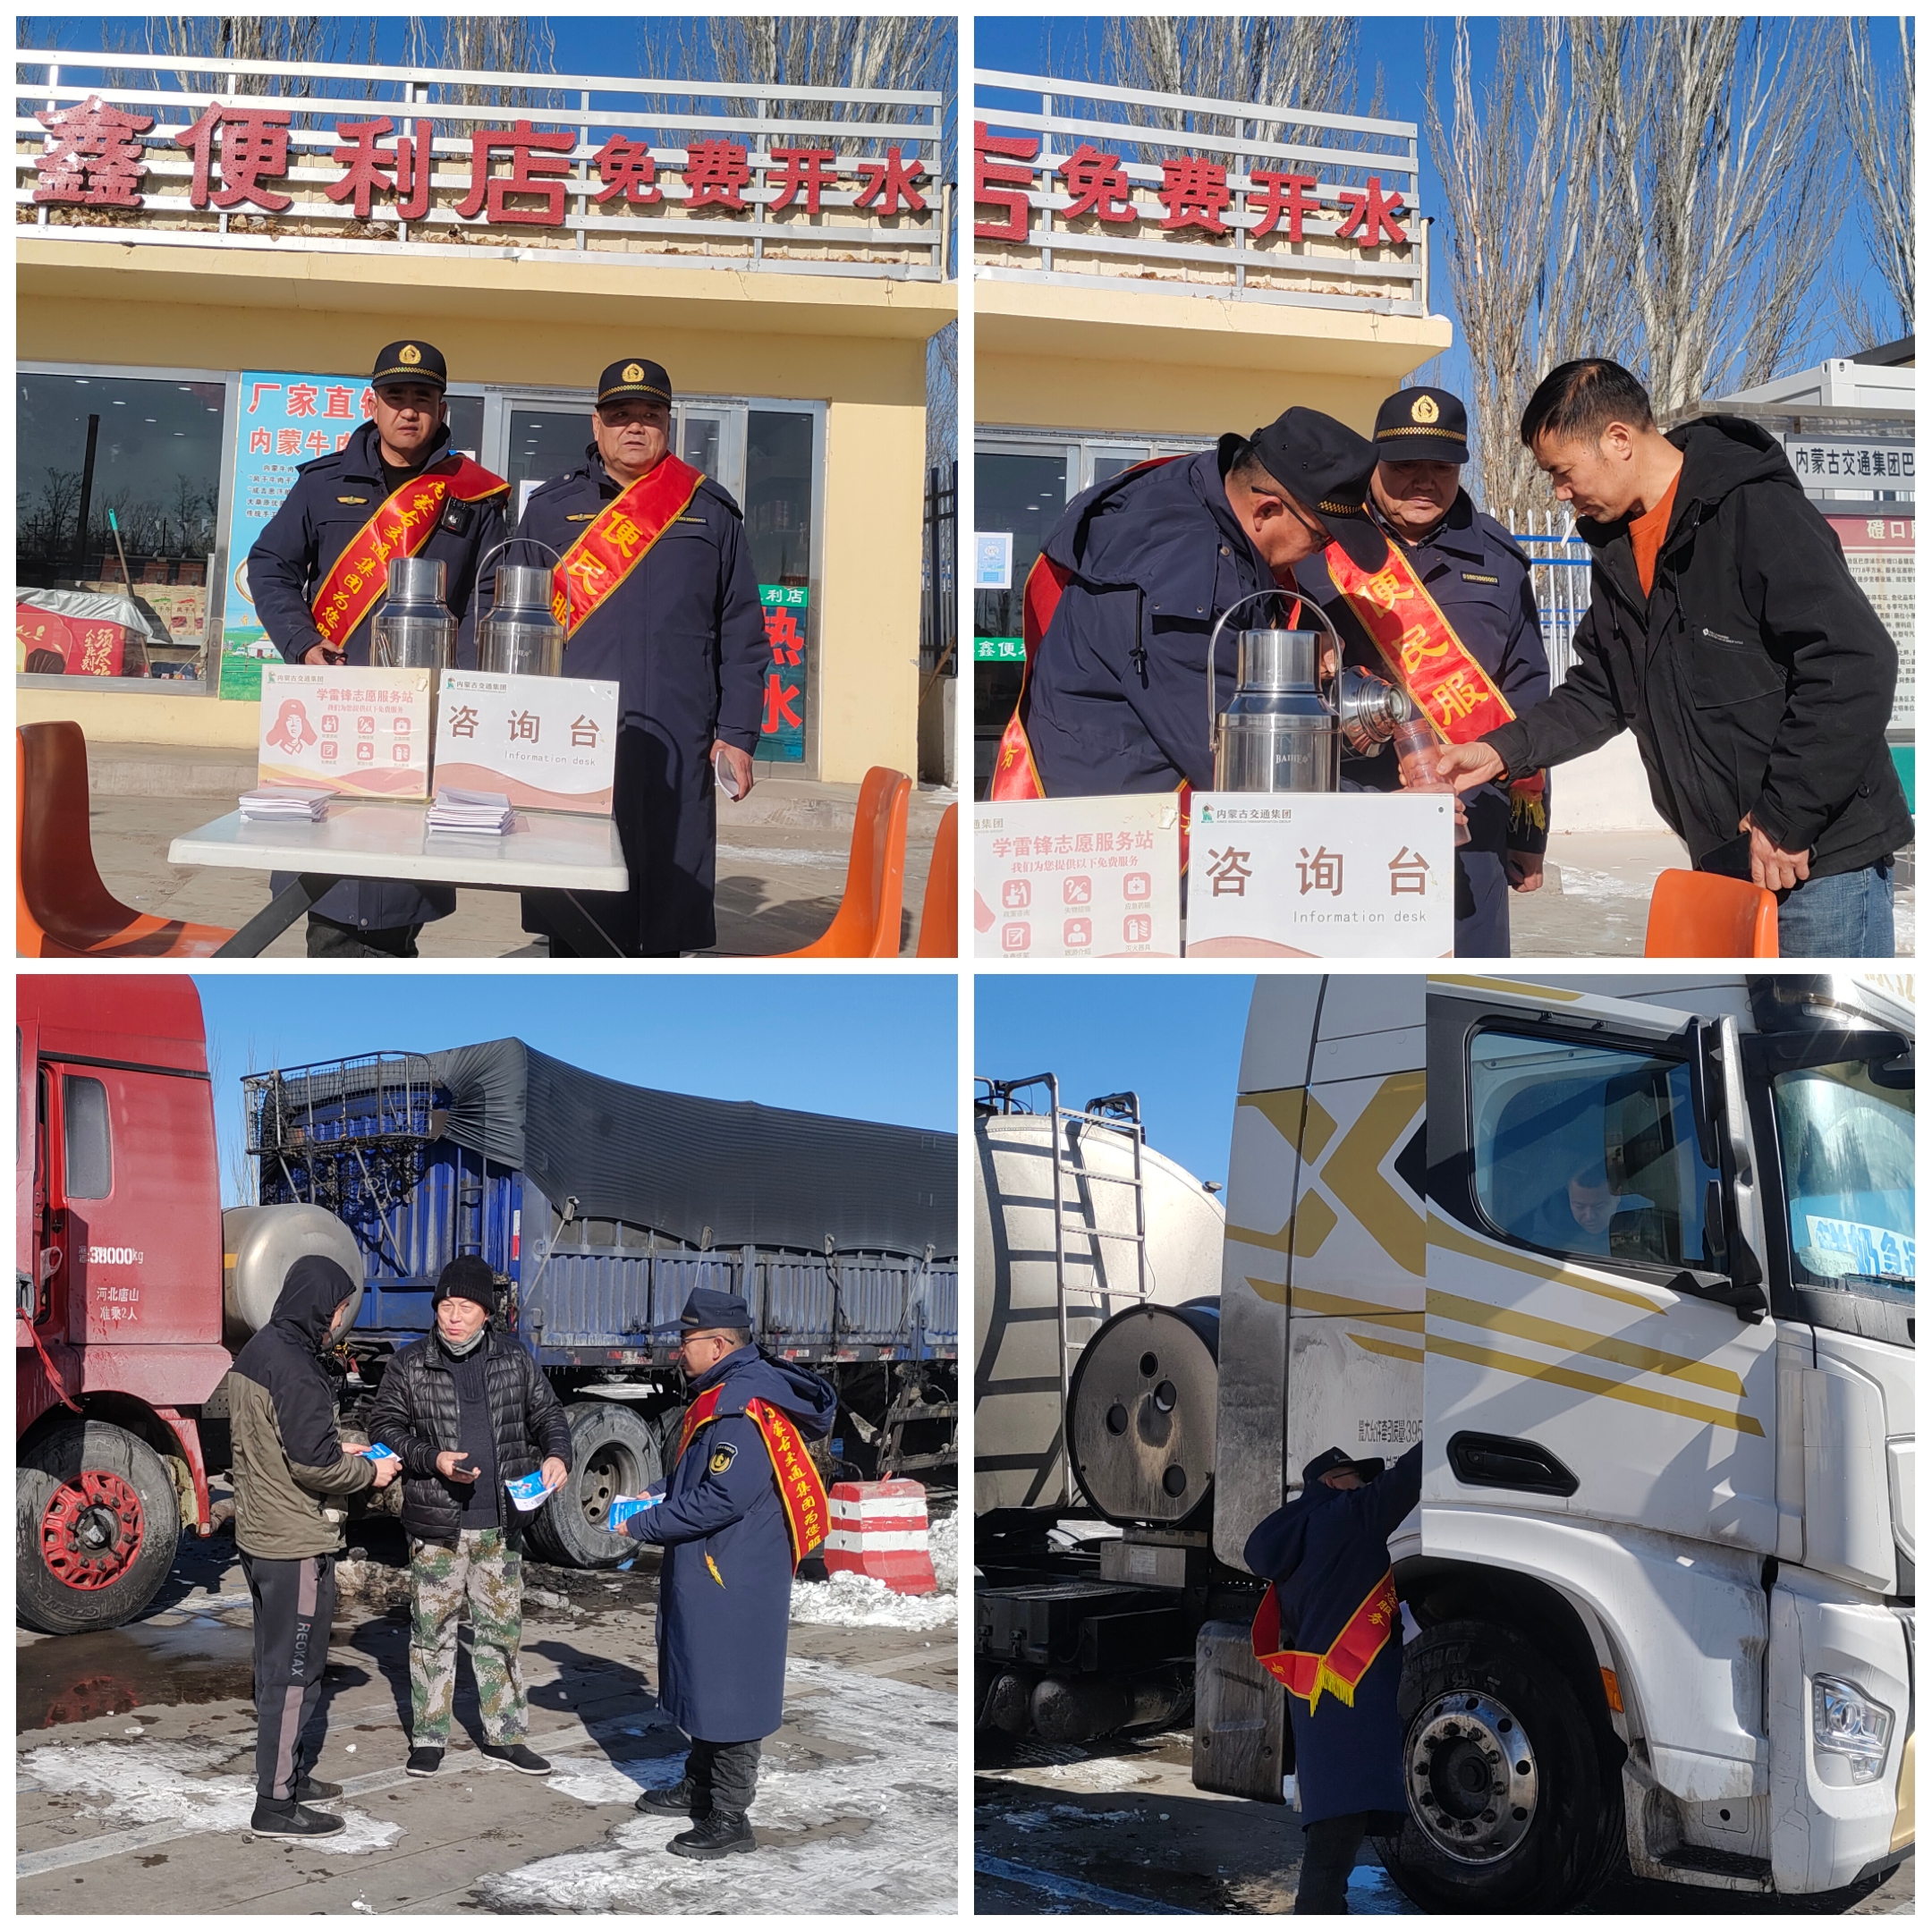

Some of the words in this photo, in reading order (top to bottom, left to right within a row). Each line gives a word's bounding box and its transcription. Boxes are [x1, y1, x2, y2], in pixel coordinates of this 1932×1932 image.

[32, 94, 577, 226] 鑫便利店
[592, 133, 928, 216] 免费开水
[1058, 143, 1408, 248] 免费开水
[1795, 447, 1915, 477] 内蒙古交通集团巴
[1866, 519, 1915, 538] 磴口
[760, 589, 804, 604] 利店
[1357, 568, 1489, 726] 便民服
[317, 688, 414, 704] 学雷锋志愿服务站
[448, 705, 600, 749] 咨询台
[504, 750, 567, 765] Information
[572, 757, 597, 767] desk
[1216, 809, 1292, 819] 内蒙古交通集团
[992, 830, 1154, 858] 学雷锋志愿服务站
[1011, 855, 1139, 873] 我们为您提供以下免费服务
[1206, 845, 1430, 897] 咨询台
[1293, 911, 1385, 923] Information
[1394, 911, 1427, 922] desk
[96, 1287, 140, 1302] 河北唐山
[99, 1306, 138, 1321] 准乘2人
[291, 1622, 311, 1677] REOKAX
